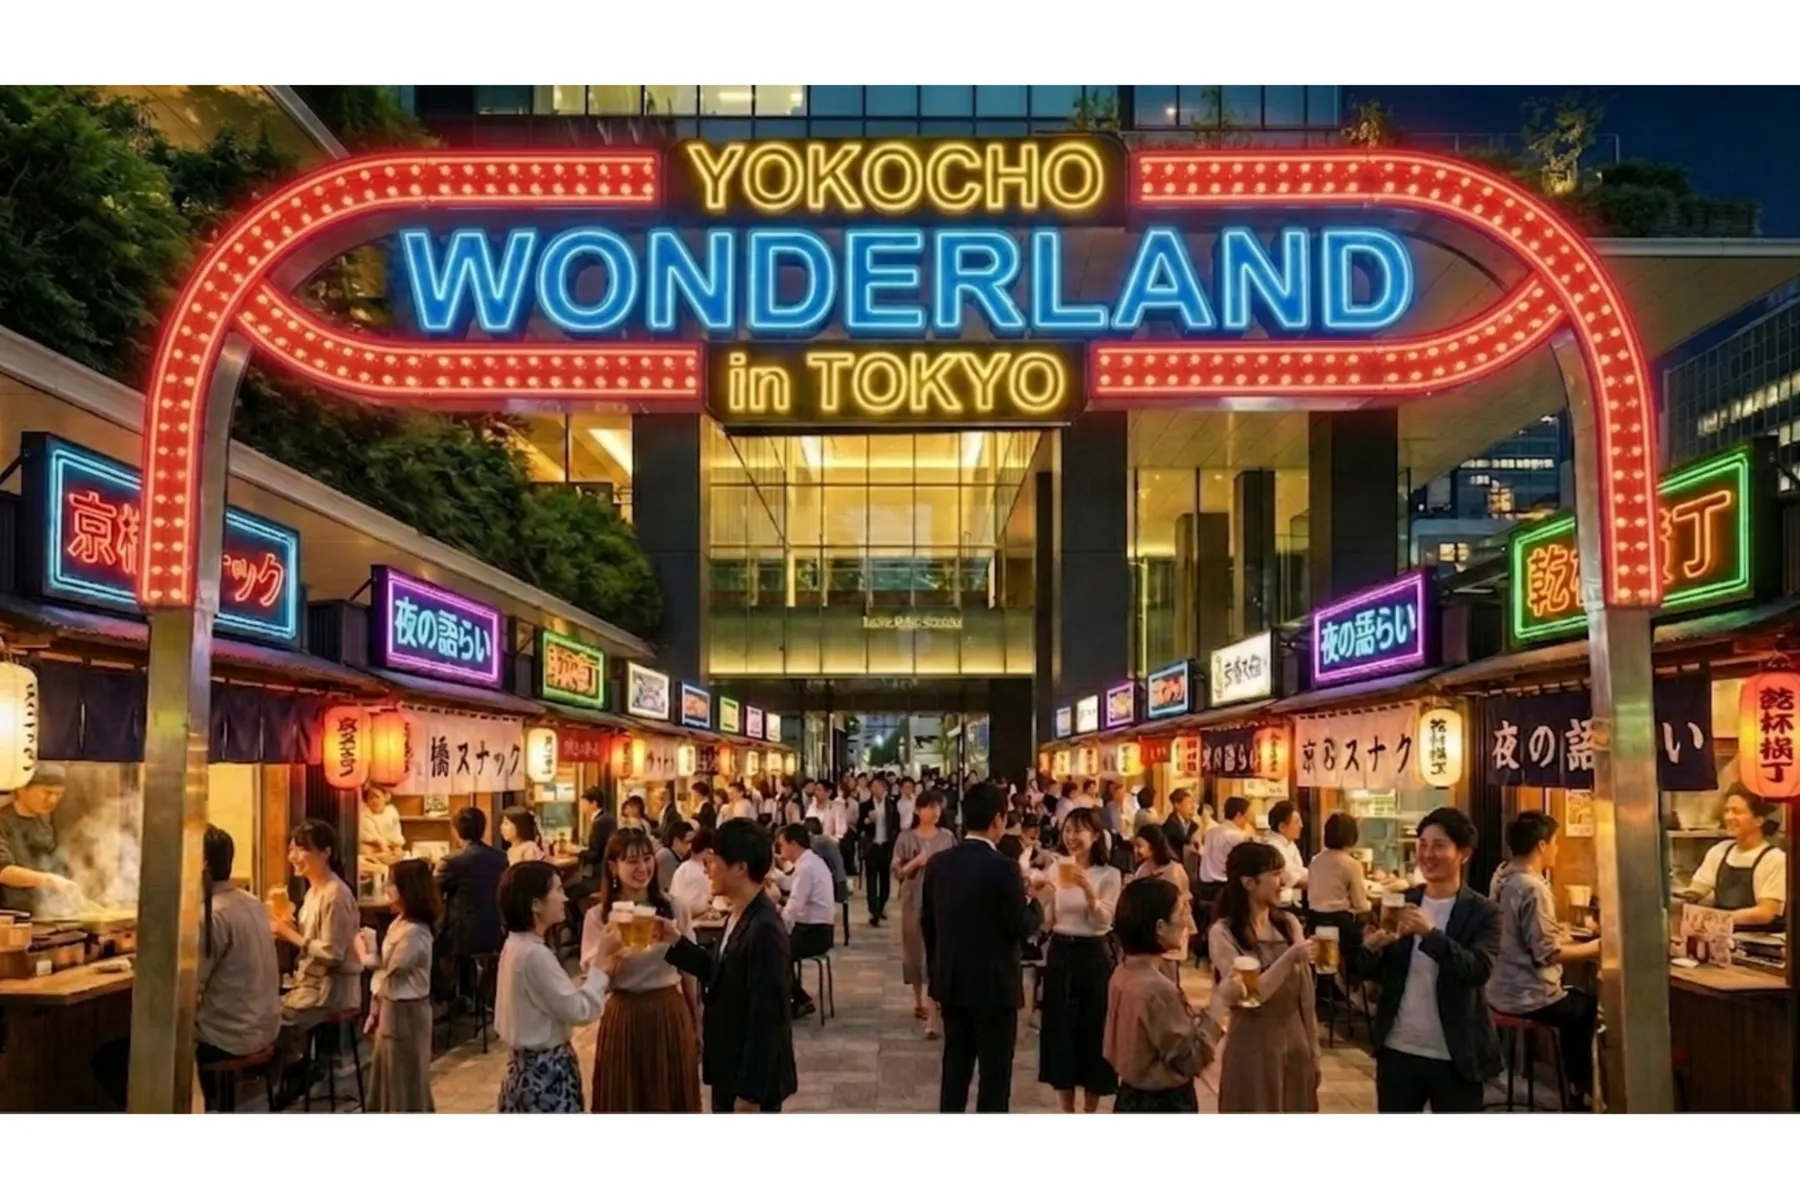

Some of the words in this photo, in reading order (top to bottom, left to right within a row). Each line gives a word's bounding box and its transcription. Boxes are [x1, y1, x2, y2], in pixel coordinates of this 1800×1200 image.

[686, 141, 1105, 214] YOKOCHO
[401, 226, 1414, 333] WONDERLAND
[727, 351, 791, 413] in
[806, 350, 1067, 413] TOKYO
[1492, 718, 1704, 772] 夜の語い
